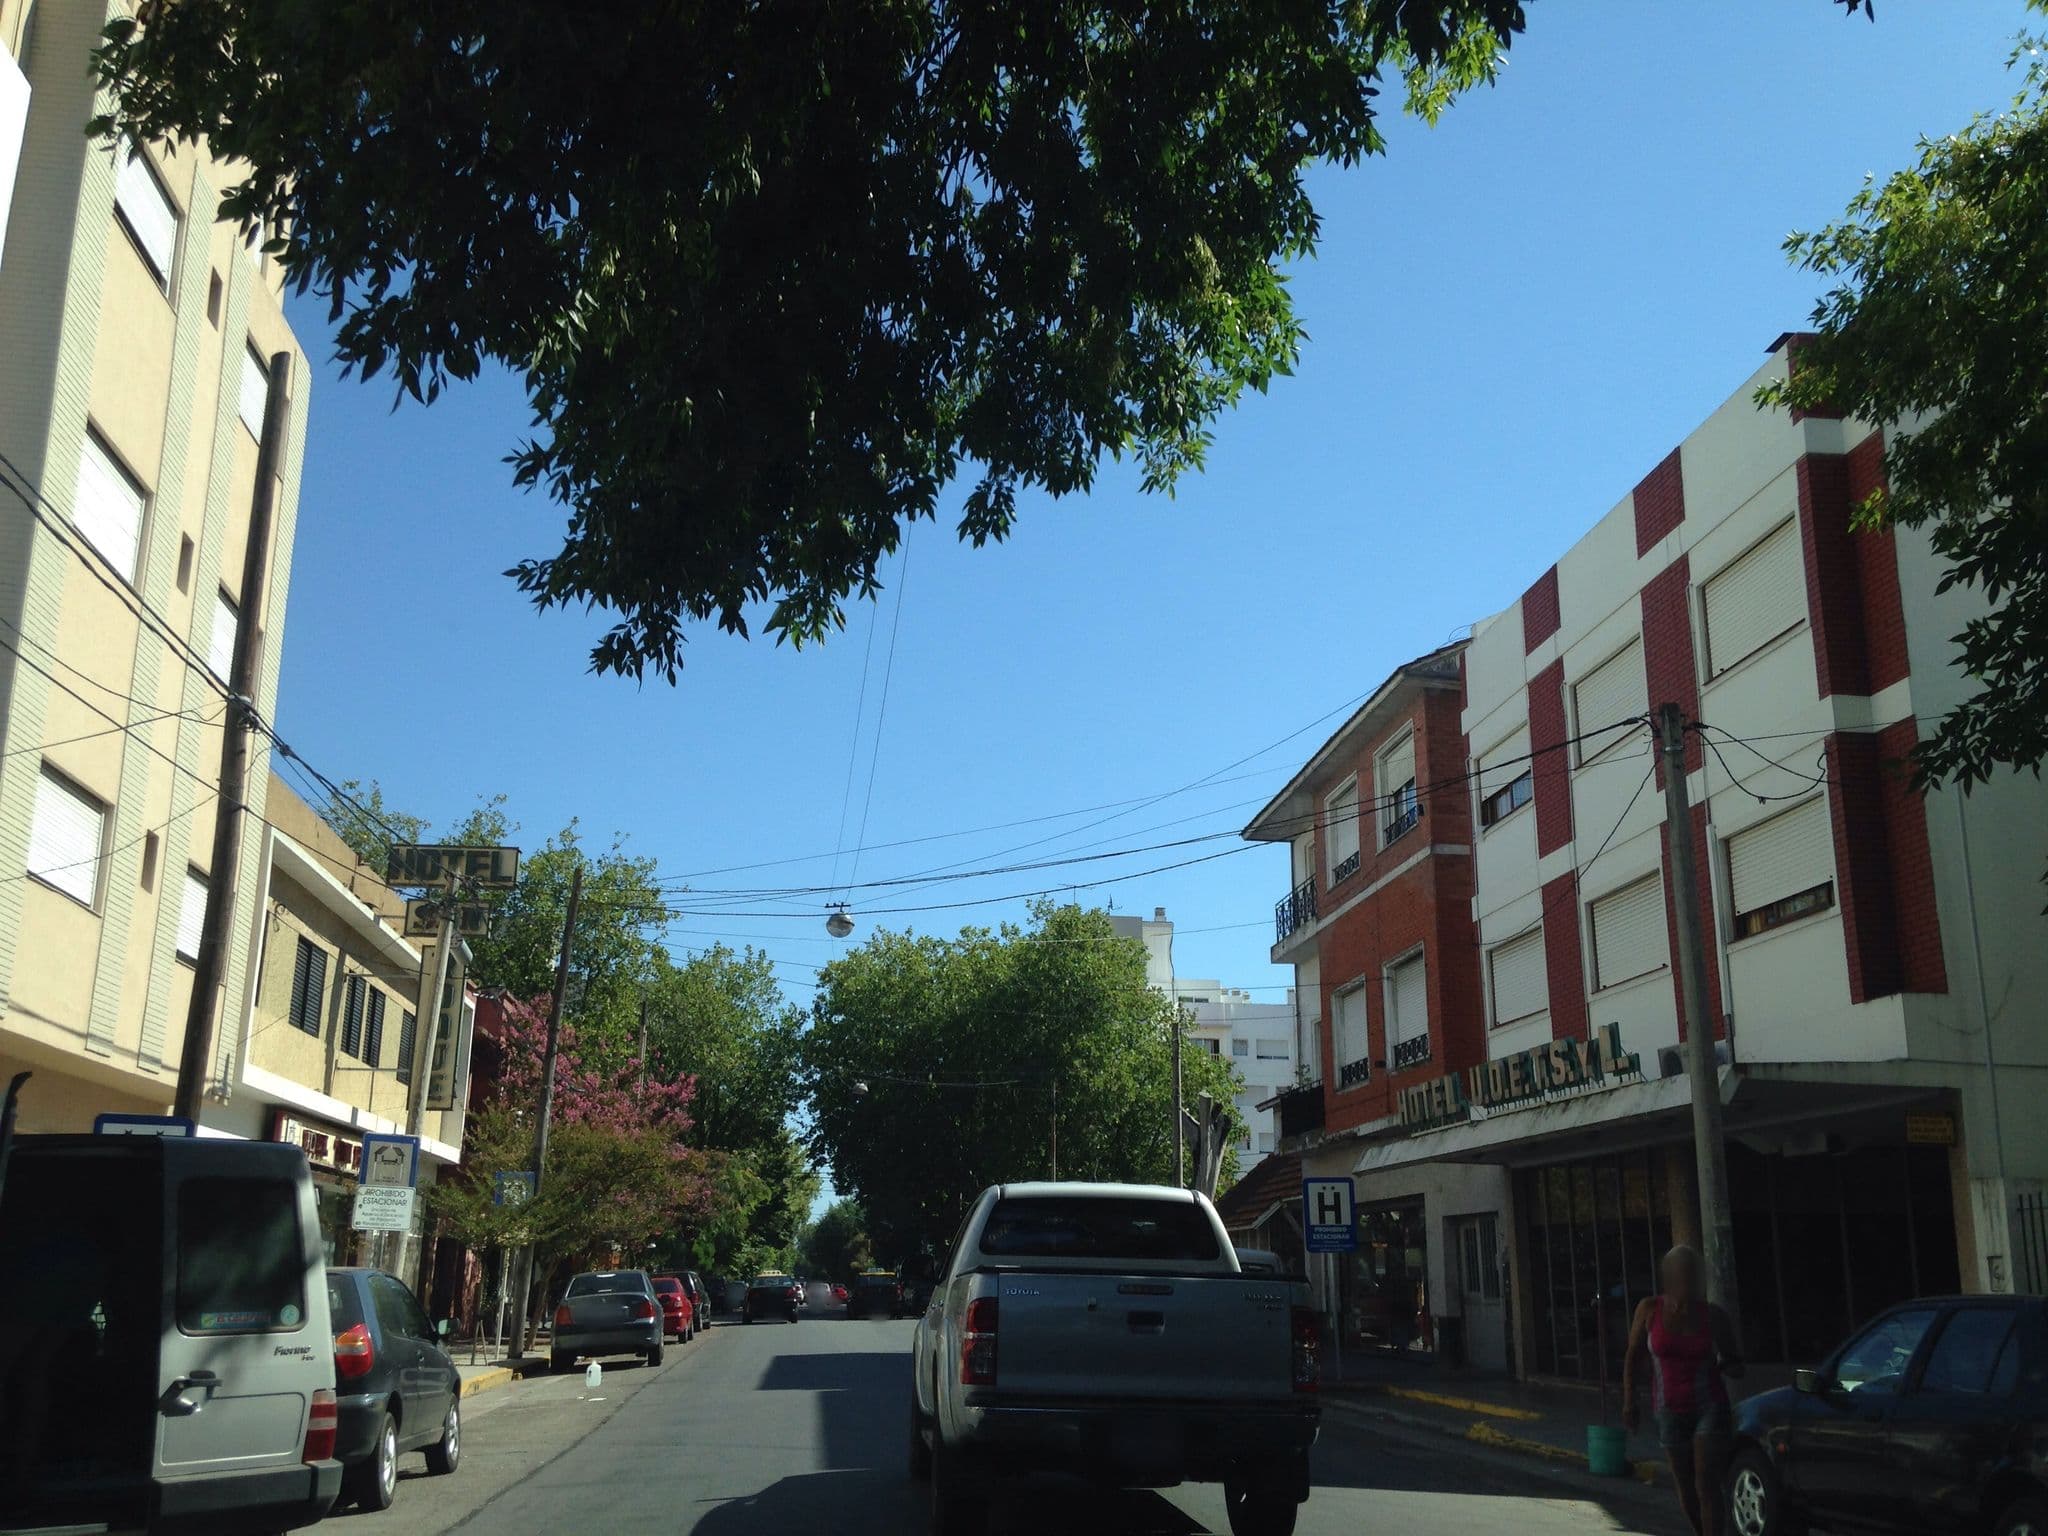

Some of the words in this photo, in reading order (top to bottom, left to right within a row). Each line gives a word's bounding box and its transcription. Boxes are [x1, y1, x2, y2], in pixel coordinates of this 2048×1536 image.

[389, 848, 513, 881] HOTEL
[412, 904, 483, 932] SN
[1396, 1073, 1459, 1127] HOTEL
